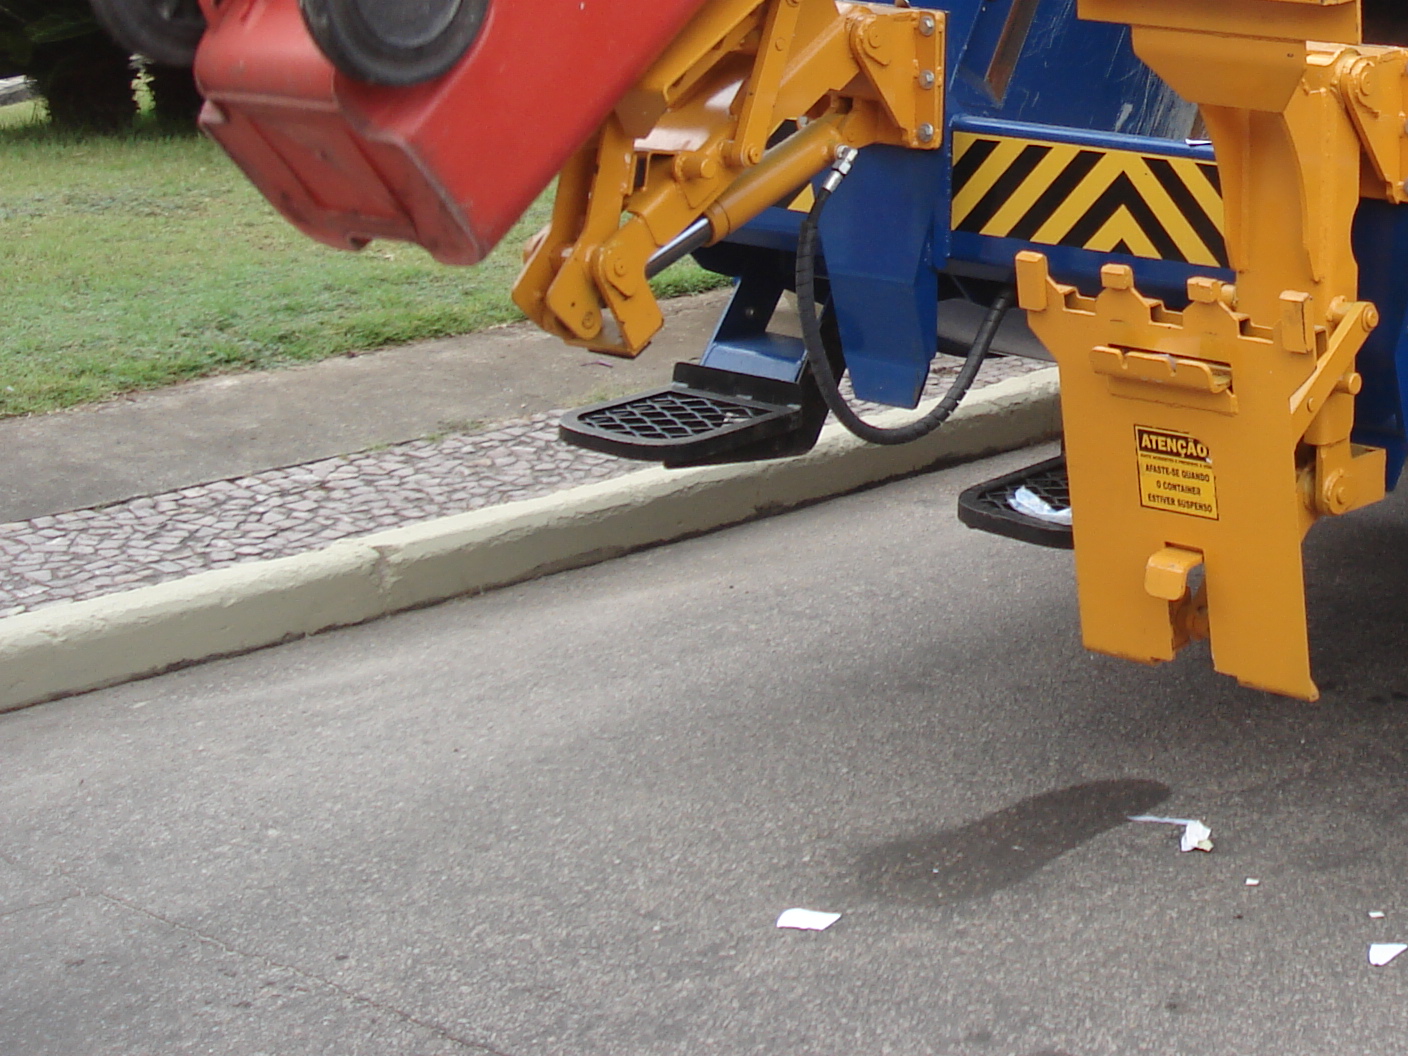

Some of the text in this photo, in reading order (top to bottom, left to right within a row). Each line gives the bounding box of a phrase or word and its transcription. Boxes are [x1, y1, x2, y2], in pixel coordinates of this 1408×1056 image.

[1141, 433, 1208, 458] ATENÇÃO
[1145, 464, 1210, 482] AFASTE-SE QUANDO
[1156, 480, 1201, 496] O CONTAINER
[1148, 493, 1213, 514] ESTIVER SUSPENSO
